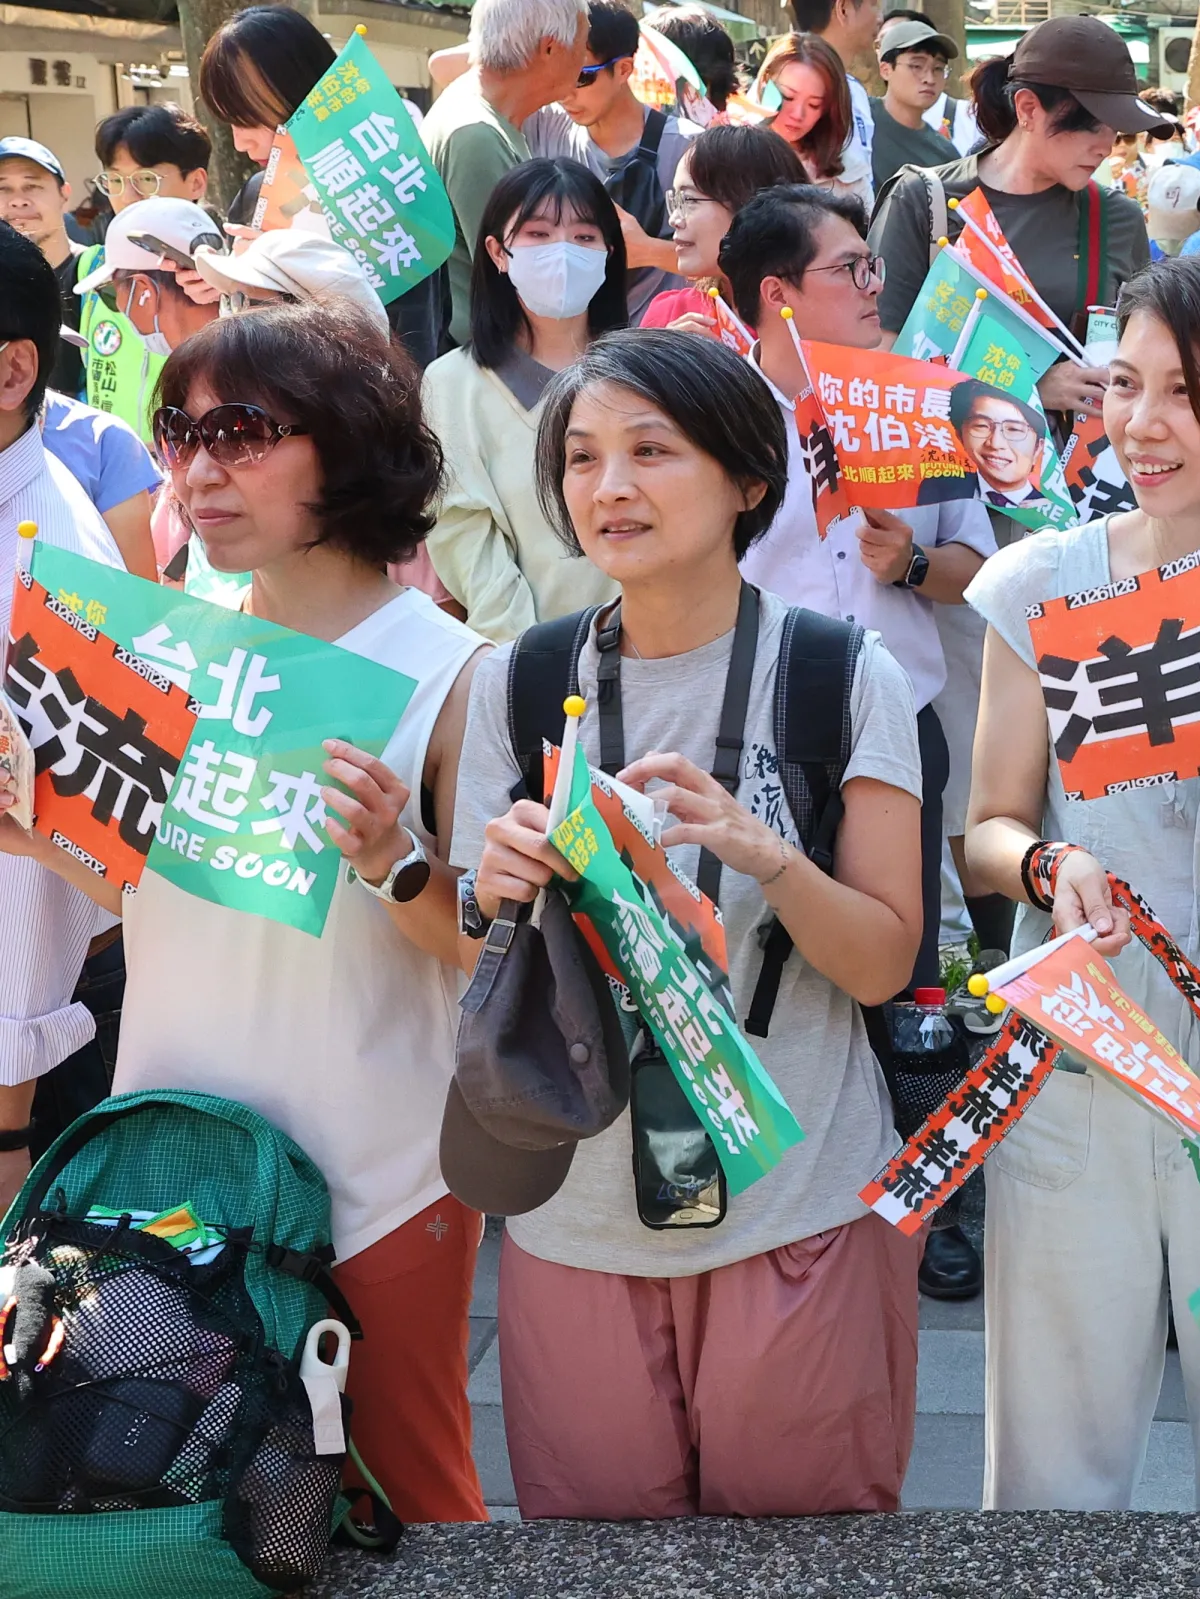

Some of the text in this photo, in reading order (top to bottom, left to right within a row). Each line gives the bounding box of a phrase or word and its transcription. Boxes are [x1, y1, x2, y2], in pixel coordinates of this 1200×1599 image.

[349, 111, 428, 205] 台北
[303, 137, 422, 276] 順起來
[818, 372, 952, 421] 你的市長
[823, 405, 956, 453] 沈伯洋
[843, 464, 915, 484] 北順起來
[1068, 577, 1138, 609] 20261128
[45, 592, 98, 641] 20261128
[115, 646, 172, 693] 20261128
[172, 739, 328, 854] 起來
[1106, 772, 1175, 797] 20261128
[52, 831, 106, 877] 20261128
[210, 846, 317, 896] SOON
